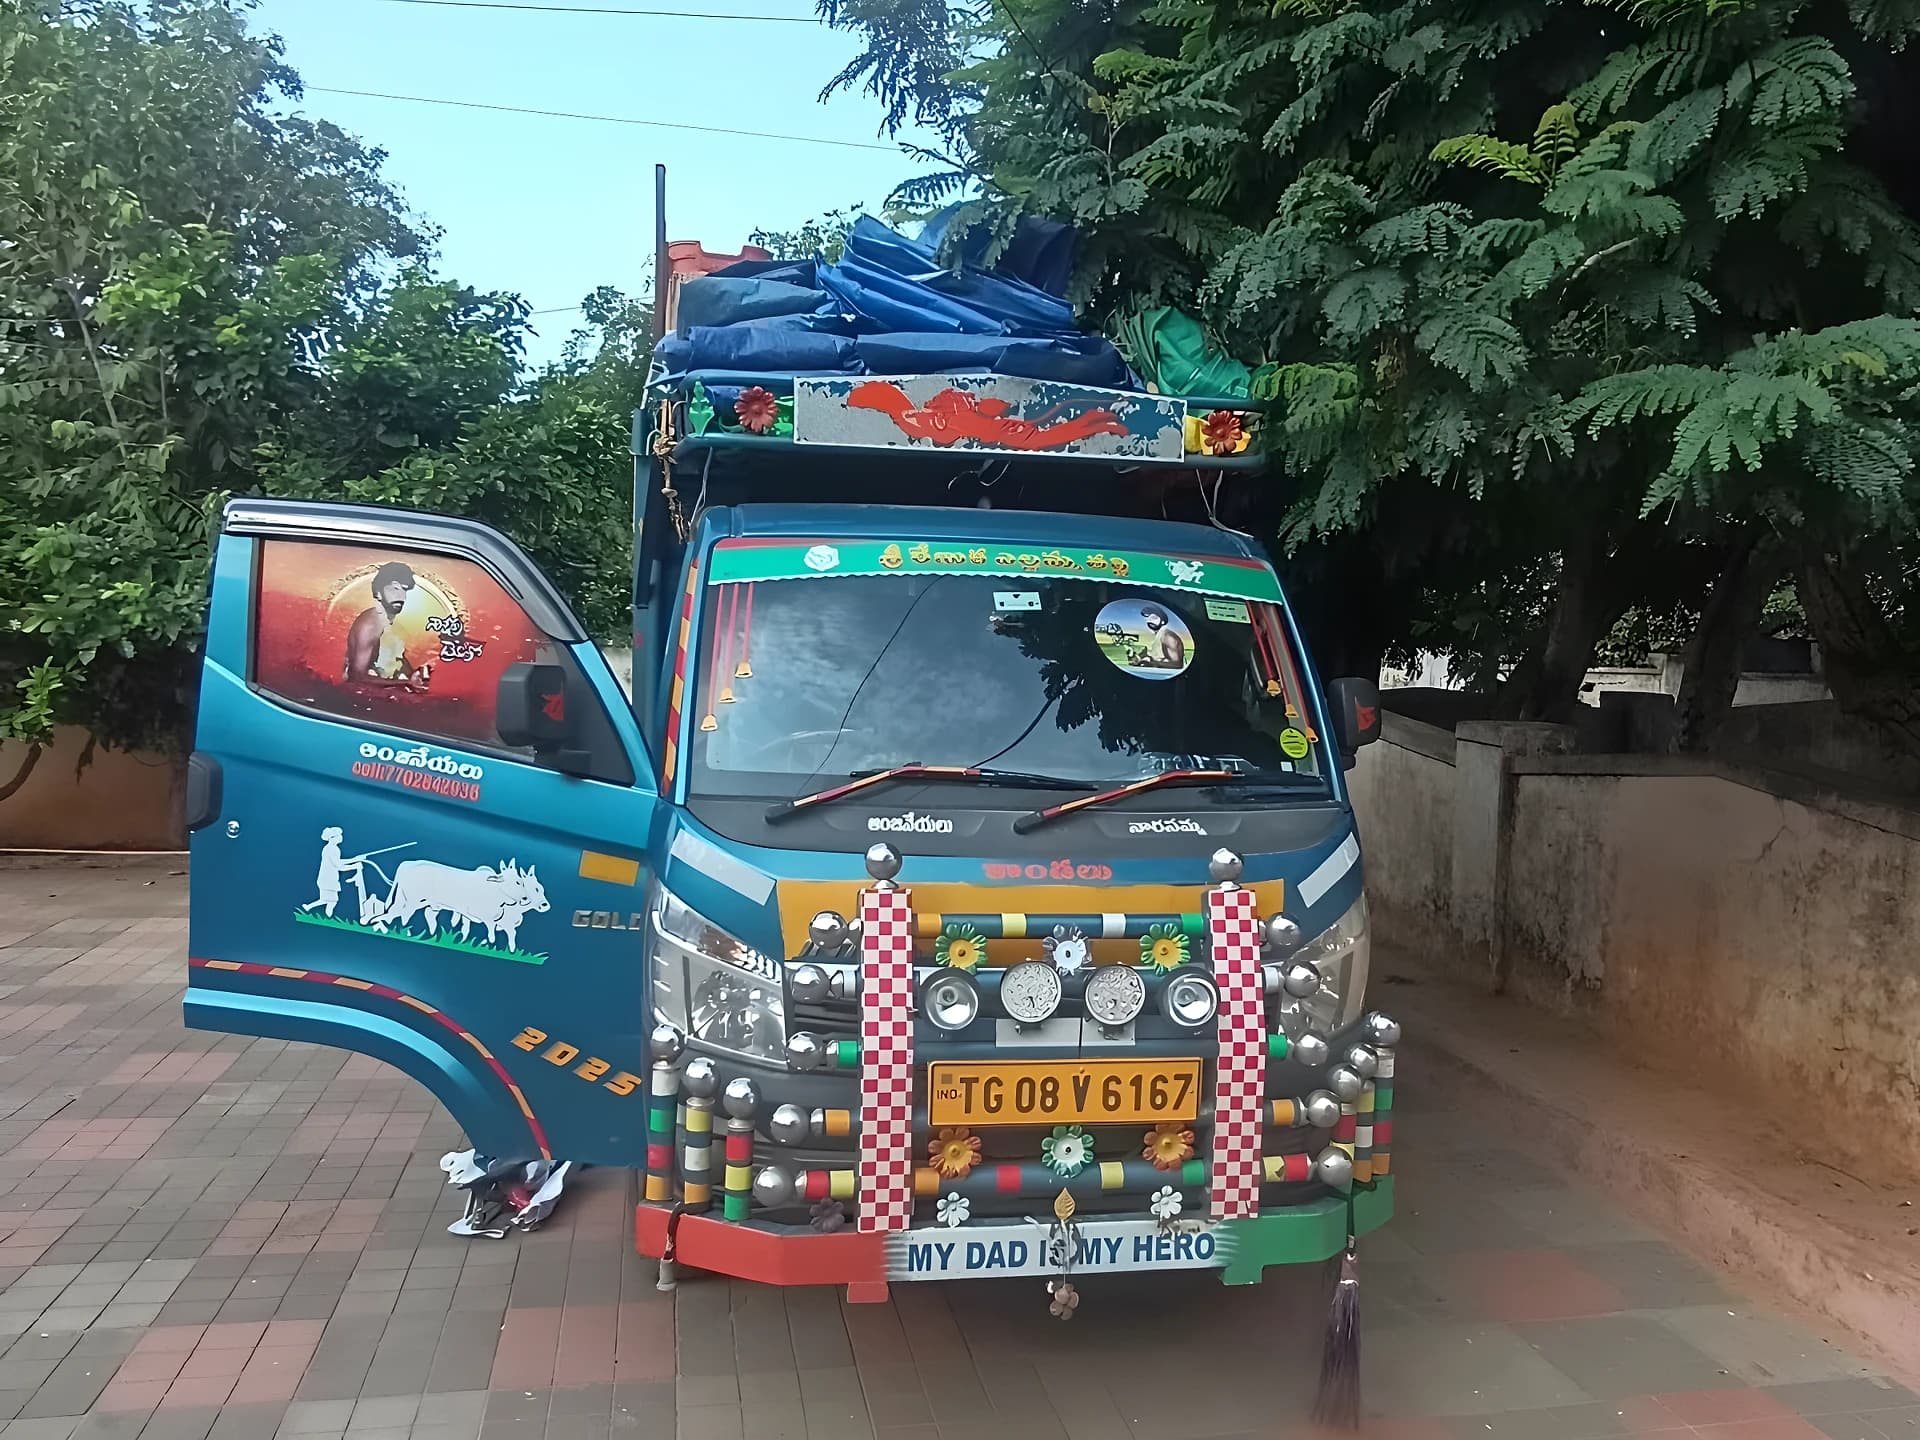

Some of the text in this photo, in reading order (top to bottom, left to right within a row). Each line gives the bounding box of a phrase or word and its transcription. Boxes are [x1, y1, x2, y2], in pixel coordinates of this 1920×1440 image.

[510, 1025, 643, 1097] 2025
[959, 1073, 1194, 1114] TG 08 V 6167
[908, 1242, 956, 1272] MY
[966, 1240, 1028, 1270] DAD
[1078, 1237, 1123, 1265] MY
[1133, 1232, 1216, 1263] HERO
